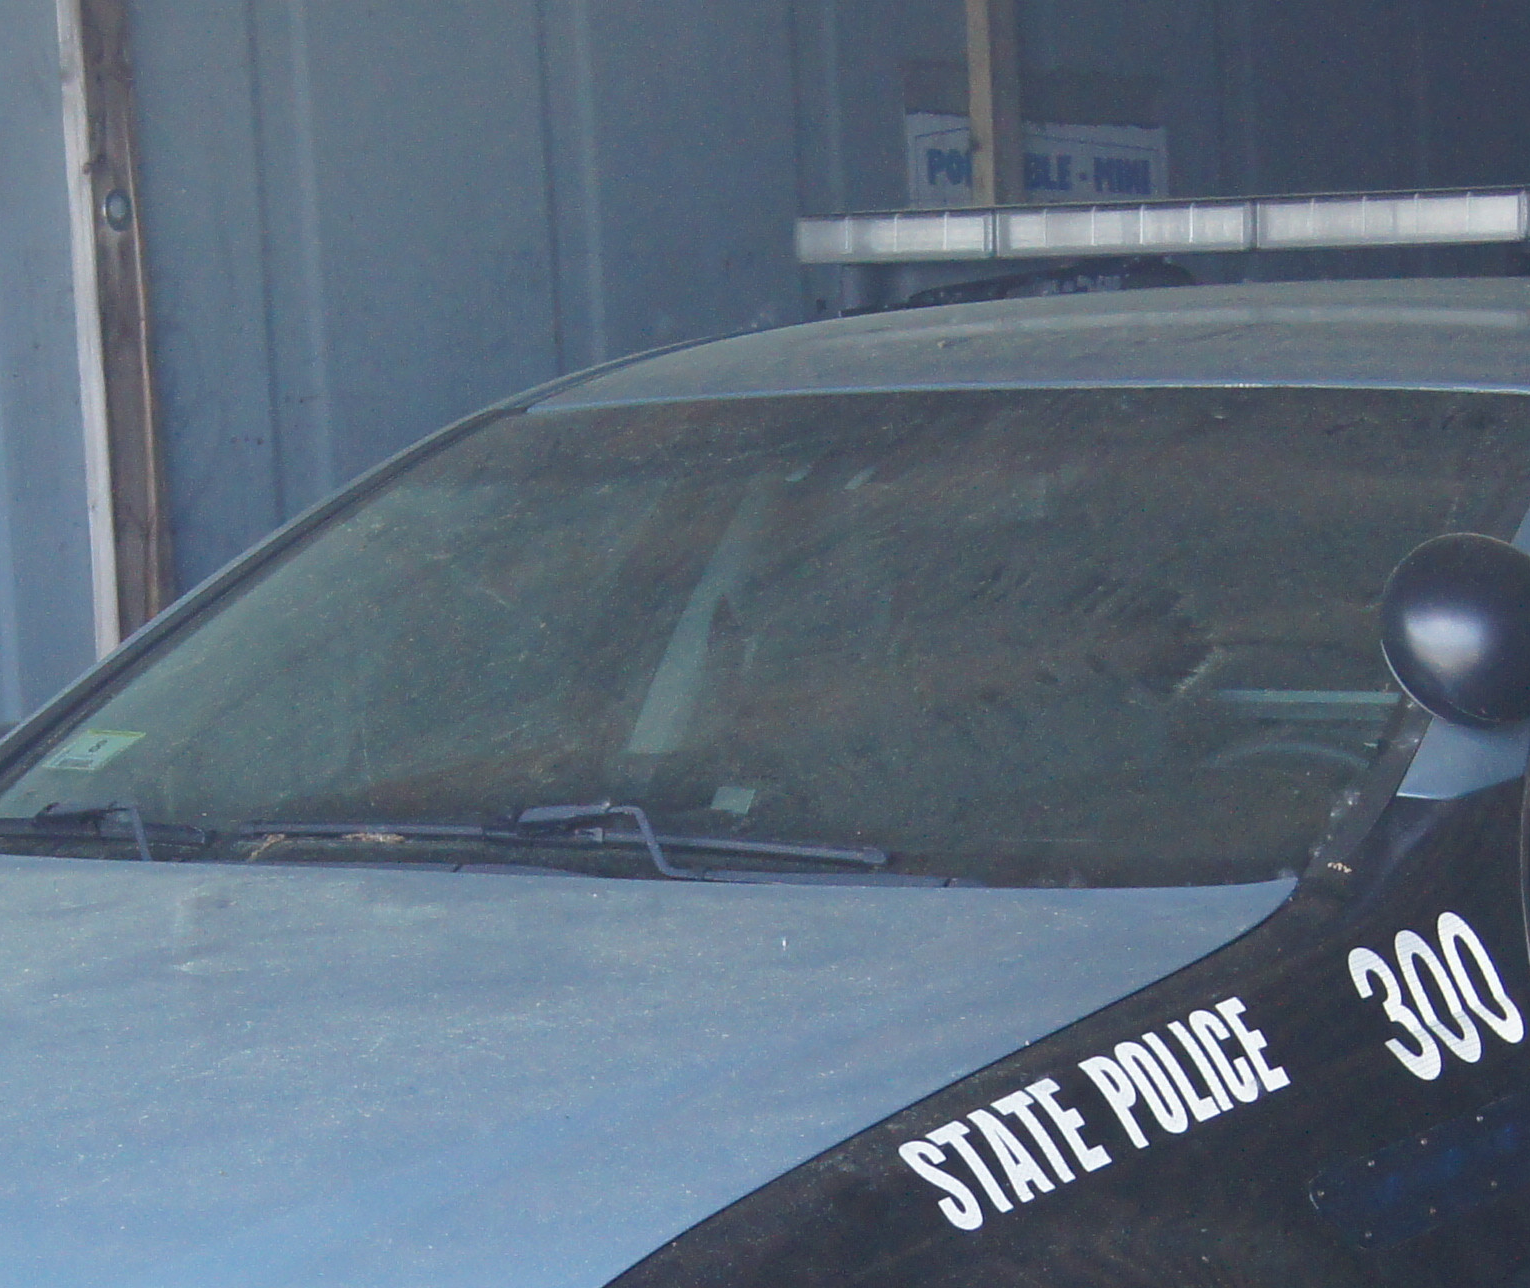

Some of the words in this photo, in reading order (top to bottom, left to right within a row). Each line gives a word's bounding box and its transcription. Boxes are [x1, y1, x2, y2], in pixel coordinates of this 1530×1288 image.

[926, 148, 1072, 190] POBLE
[1348, 911, 1525, 1081] 300
[898, 1077, 1112, 1231] STATE
[1078, 996, 1290, 1150] POLICE
